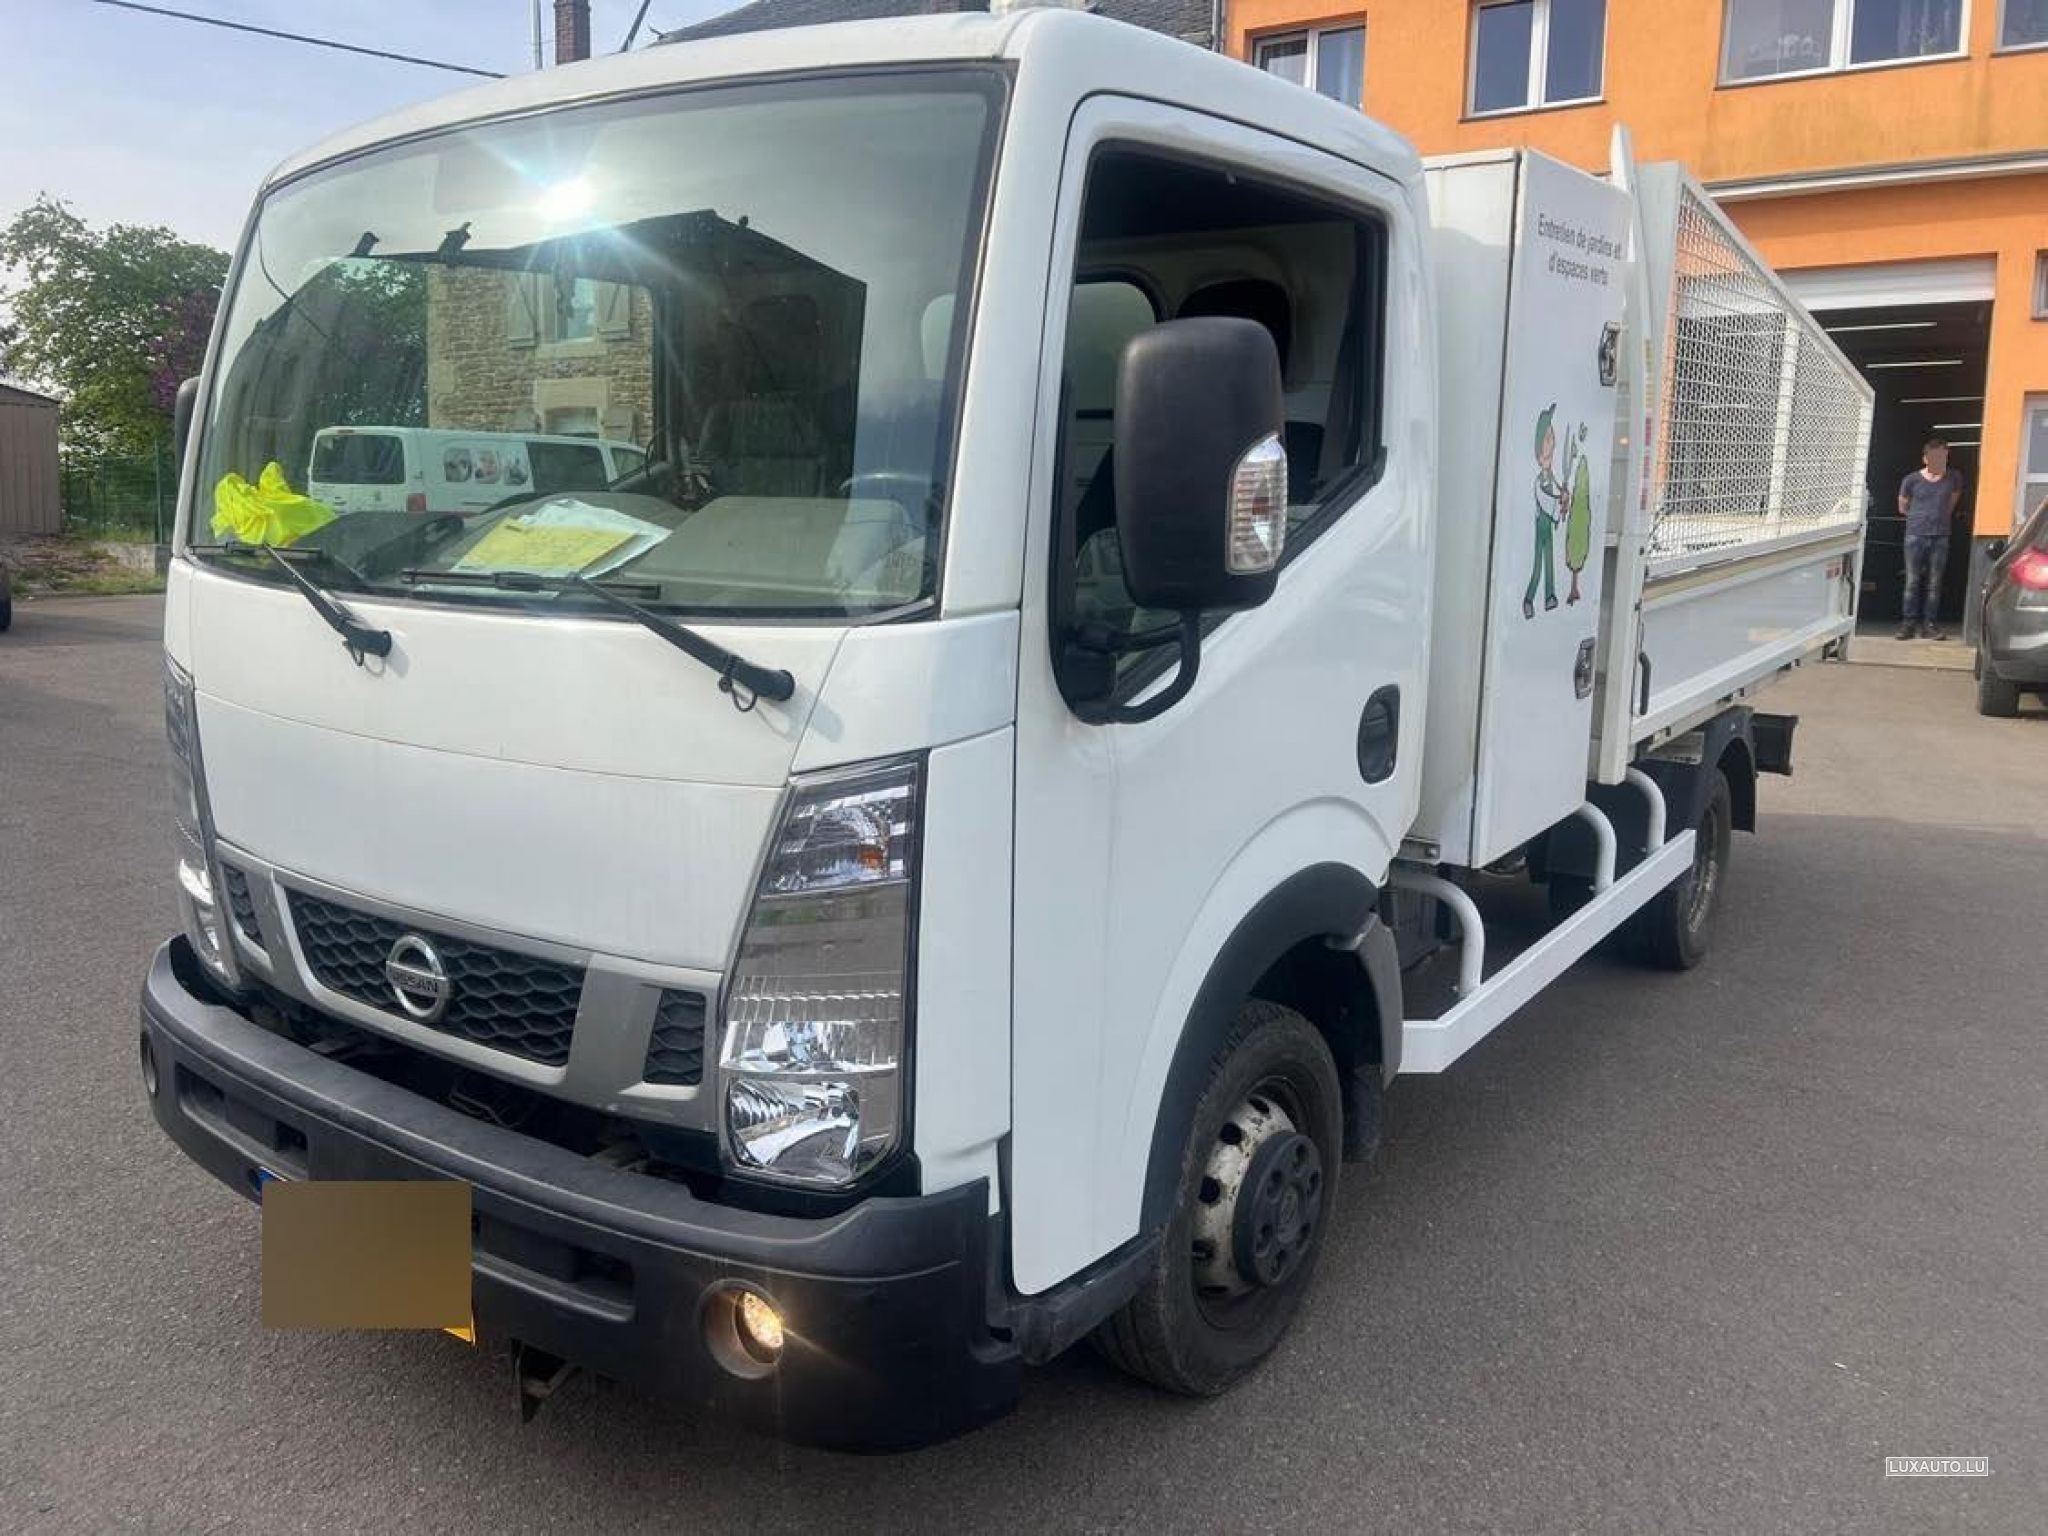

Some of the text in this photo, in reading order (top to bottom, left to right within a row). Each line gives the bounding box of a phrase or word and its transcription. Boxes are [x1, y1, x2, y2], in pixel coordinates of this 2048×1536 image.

[1538, 212, 1575, 245] Entretien
[1576, 227, 1586, 248] de
[1587, 233, 1612, 257] jardins
[1548, 251, 1608, 285] d'espaces verts
